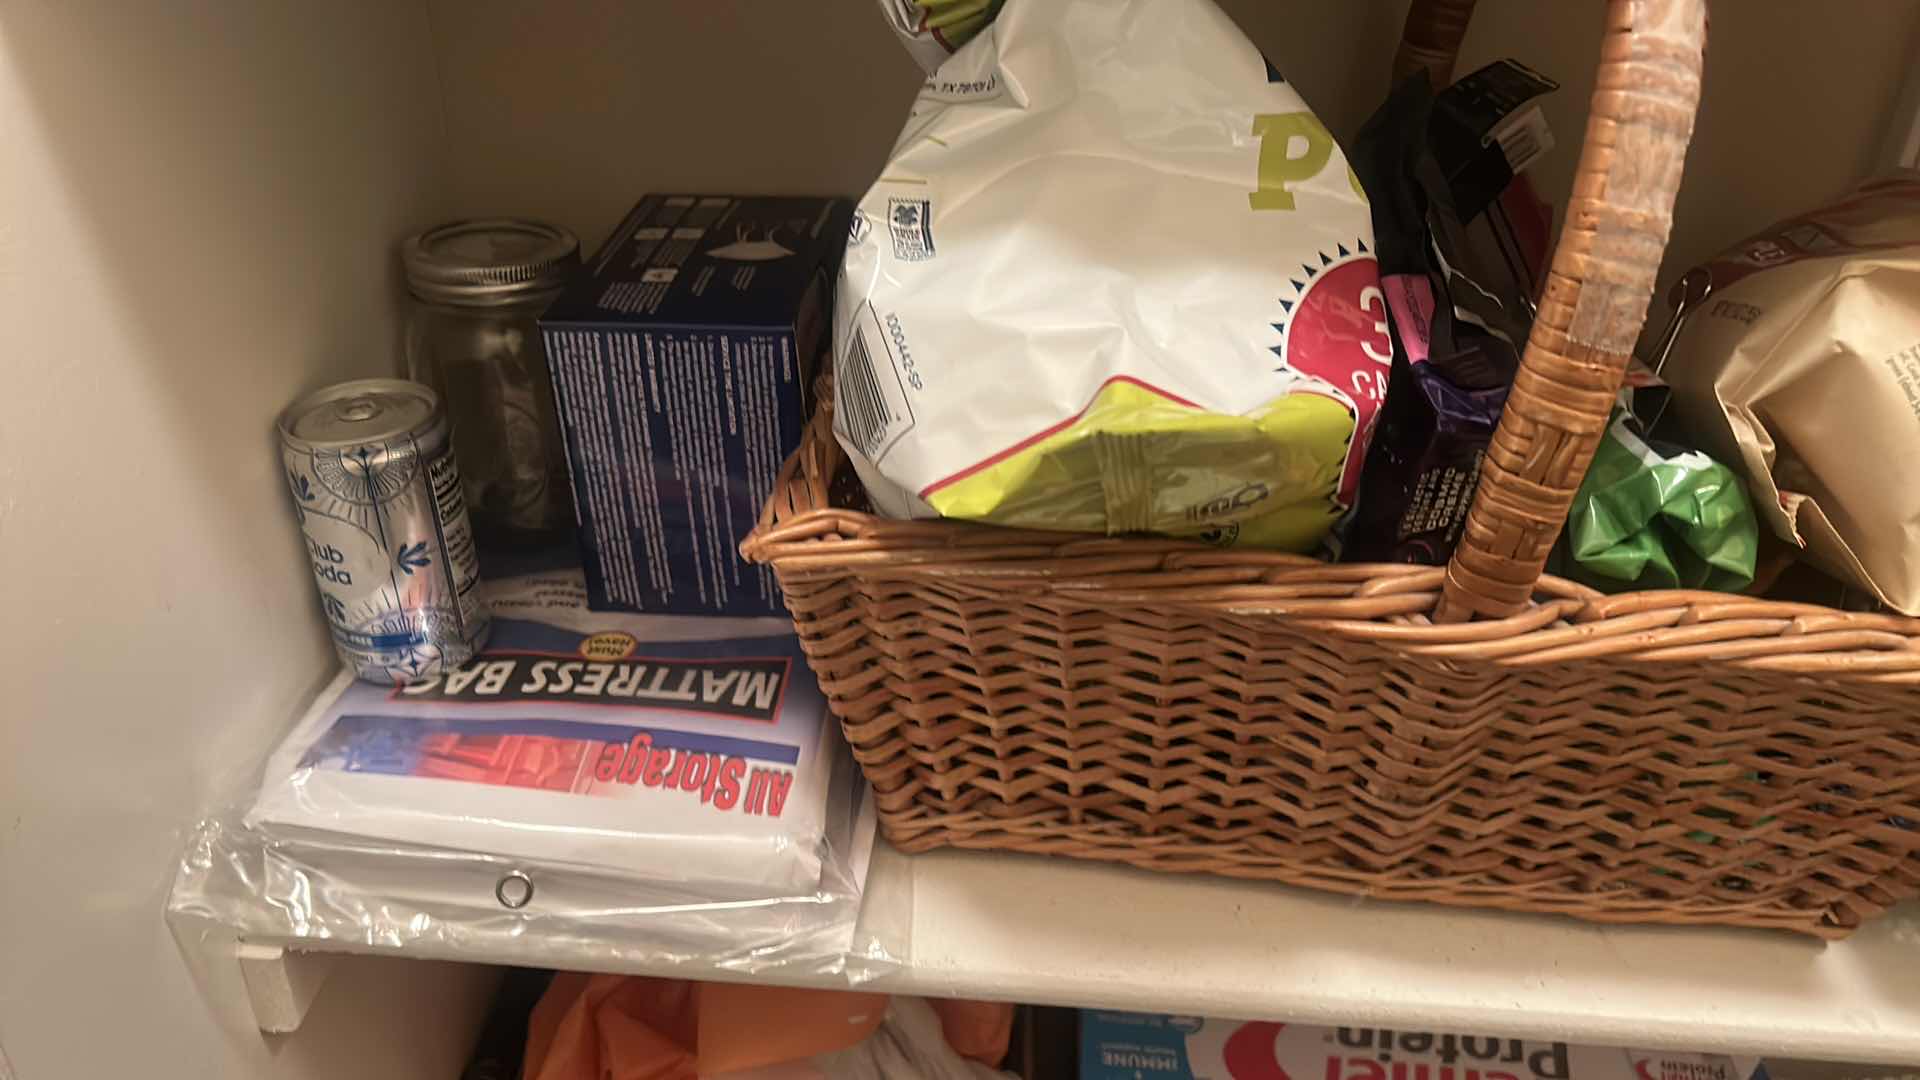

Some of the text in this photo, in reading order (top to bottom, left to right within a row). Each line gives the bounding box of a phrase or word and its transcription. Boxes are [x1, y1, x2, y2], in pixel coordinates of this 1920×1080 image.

[1248, 112, 1369, 211] P
[312, 541, 344, 564] lub
[312, 561, 353, 586] oda
[521, 660, 780, 710] MATTRESS
[596, 731, 794, 818] All Storage
